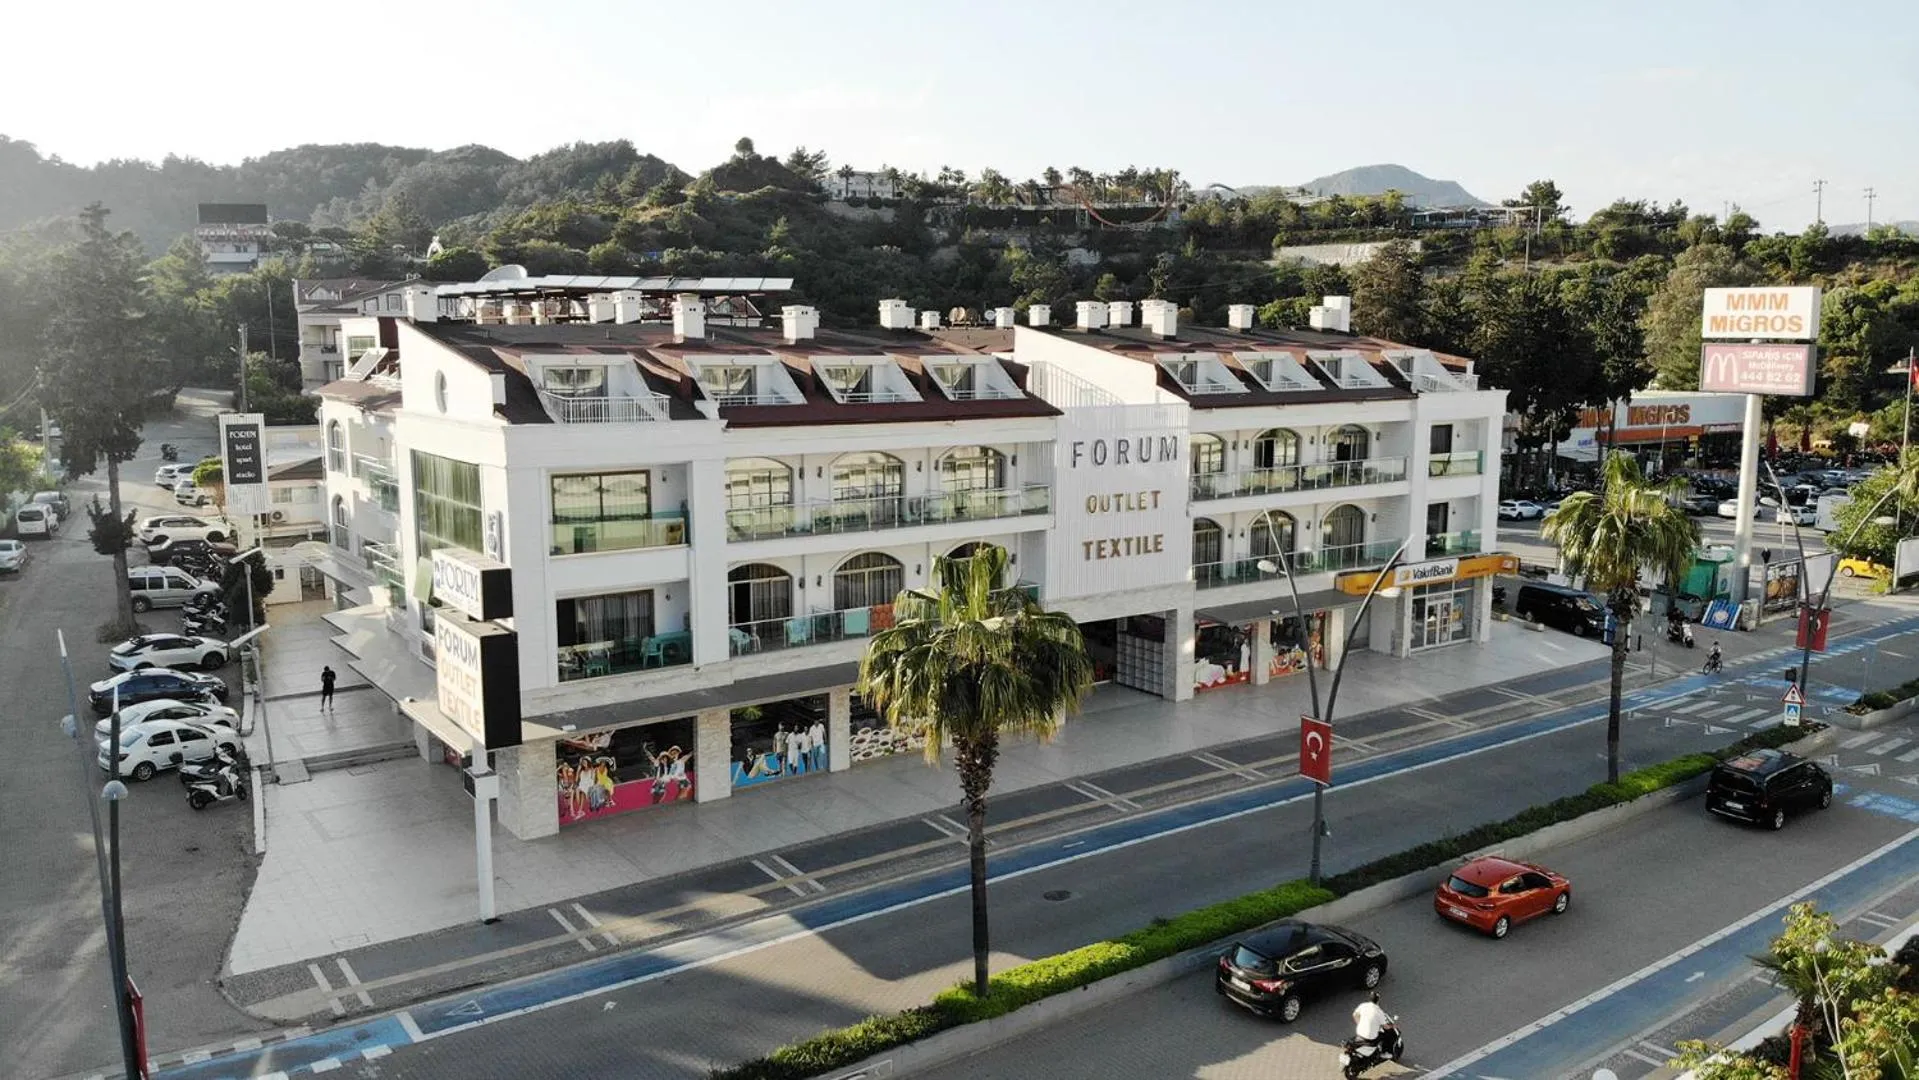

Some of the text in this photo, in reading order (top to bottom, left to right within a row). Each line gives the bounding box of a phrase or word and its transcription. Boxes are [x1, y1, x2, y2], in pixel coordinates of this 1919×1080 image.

[1726, 293, 1789, 311] MMM
[229, 430, 257, 439] FORUM
[1072, 435, 1178, 469] FORUM
[1086, 490, 1161, 514] OUTLET
[1082, 534, 1164, 561] TEXTILE
[440, 559, 479, 601] FORUM
[438, 623, 479, 671] FORUM
[440, 657, 478, 698] OUTLET
[440, 684, 481, 734] TEXTILE
